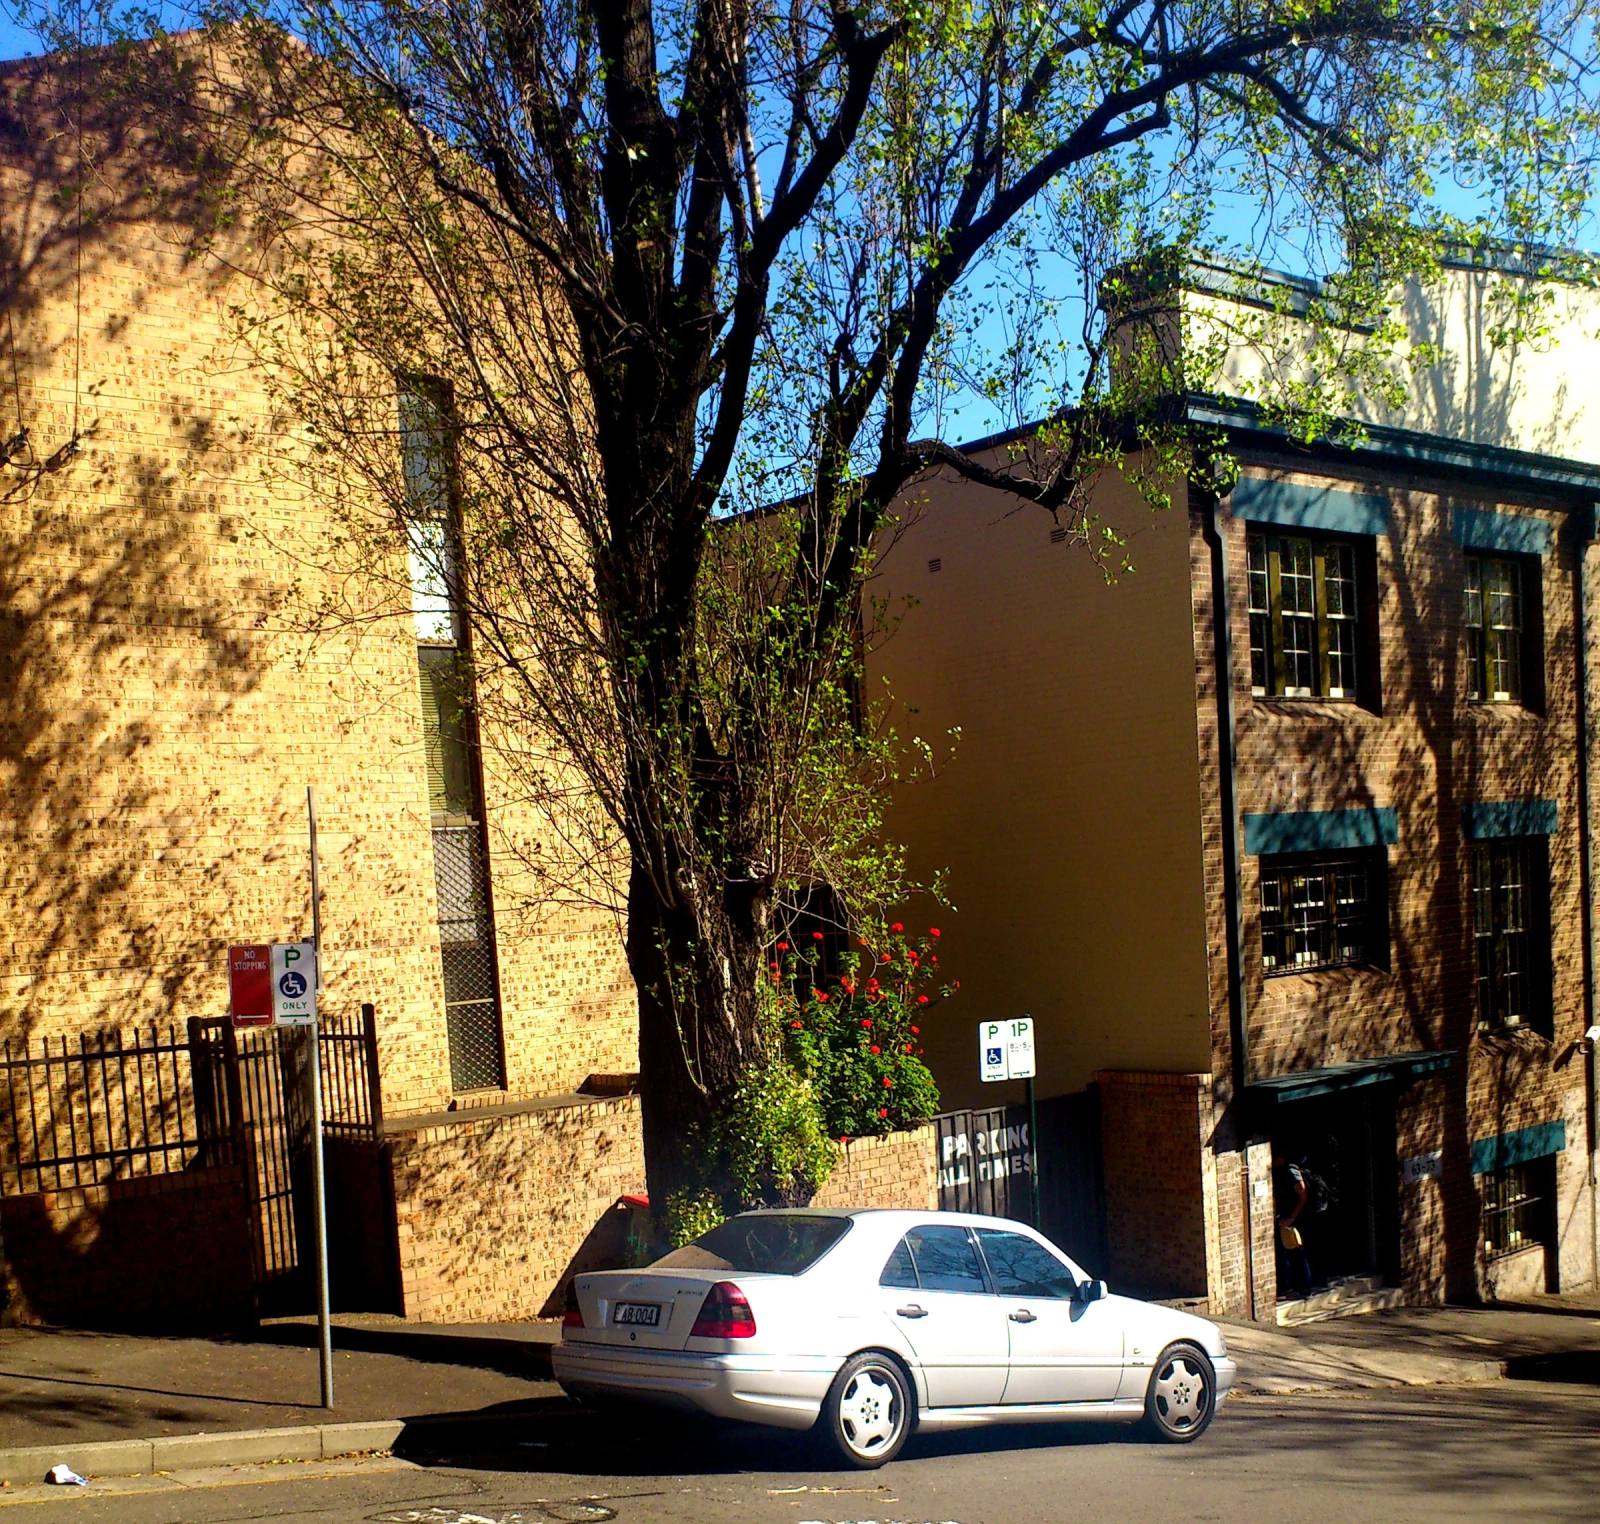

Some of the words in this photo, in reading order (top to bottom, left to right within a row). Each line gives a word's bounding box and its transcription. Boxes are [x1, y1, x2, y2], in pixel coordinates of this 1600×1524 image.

[244, 950, 256, 959] NO
[285, 949, 300, 968] P
[234, 961, 267, 970] STOPPING
[989, 1025, 999, 1040] P
[1011, 1022, 1028, 1037] 1P
[938, 1164, 970, 1189] ALL
[979, 1152, 1033, 1182] TIMES
